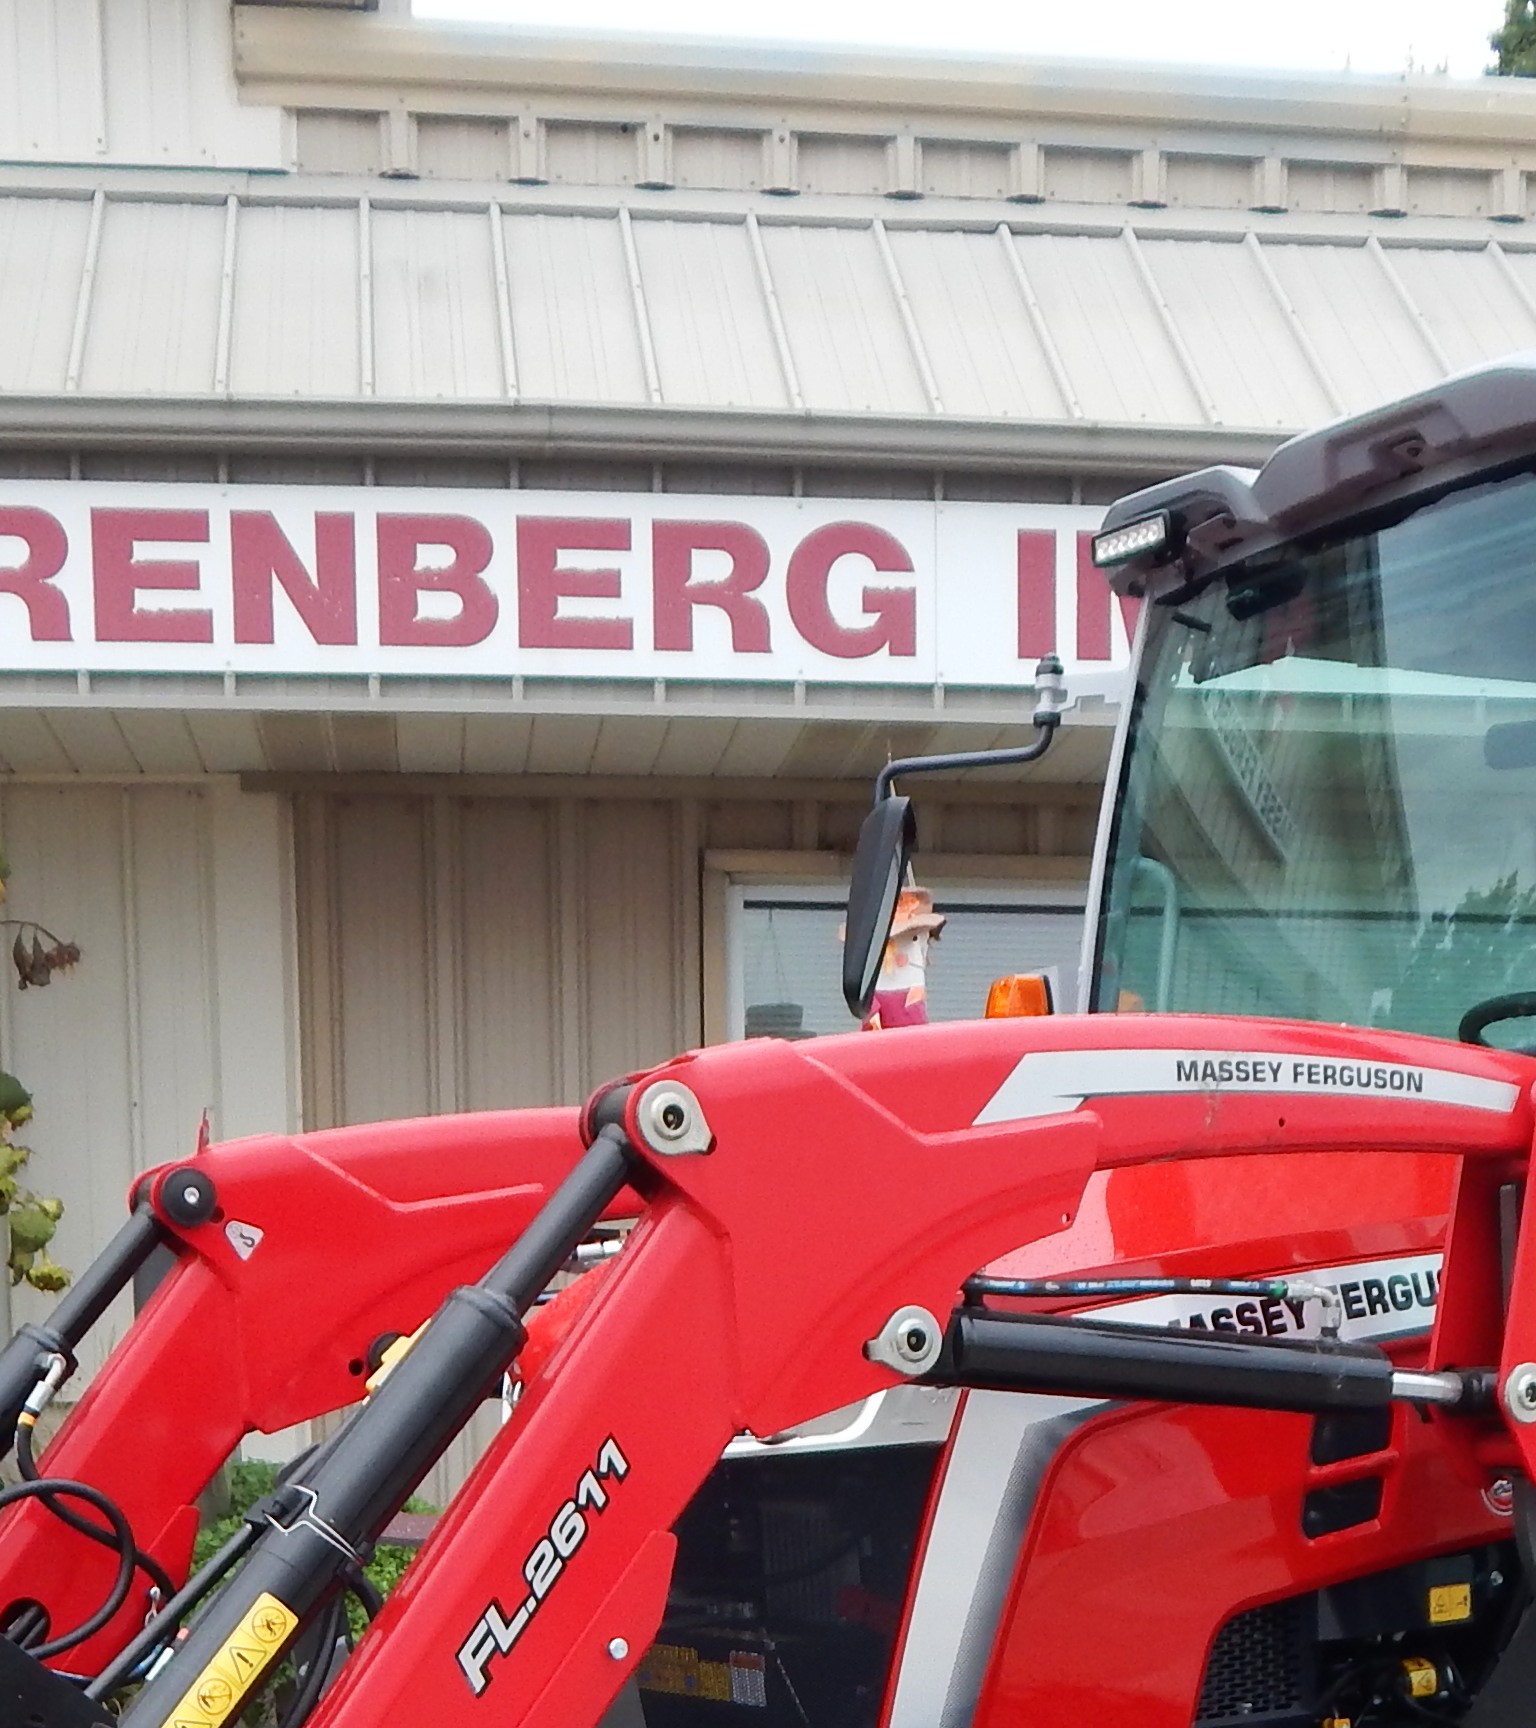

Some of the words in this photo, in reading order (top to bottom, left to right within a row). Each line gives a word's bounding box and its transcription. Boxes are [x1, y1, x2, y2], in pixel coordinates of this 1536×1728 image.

[1176, 1059, 1283, 1083] MASSEY
[1292, 1062, 1424, 1092] FERGUSON
[1167, 1296, 1307, 1337] ASSEY
[1321, 1268, 1443, 1321] ERGU
[455, 1433, 631, 1698] FL.2611
